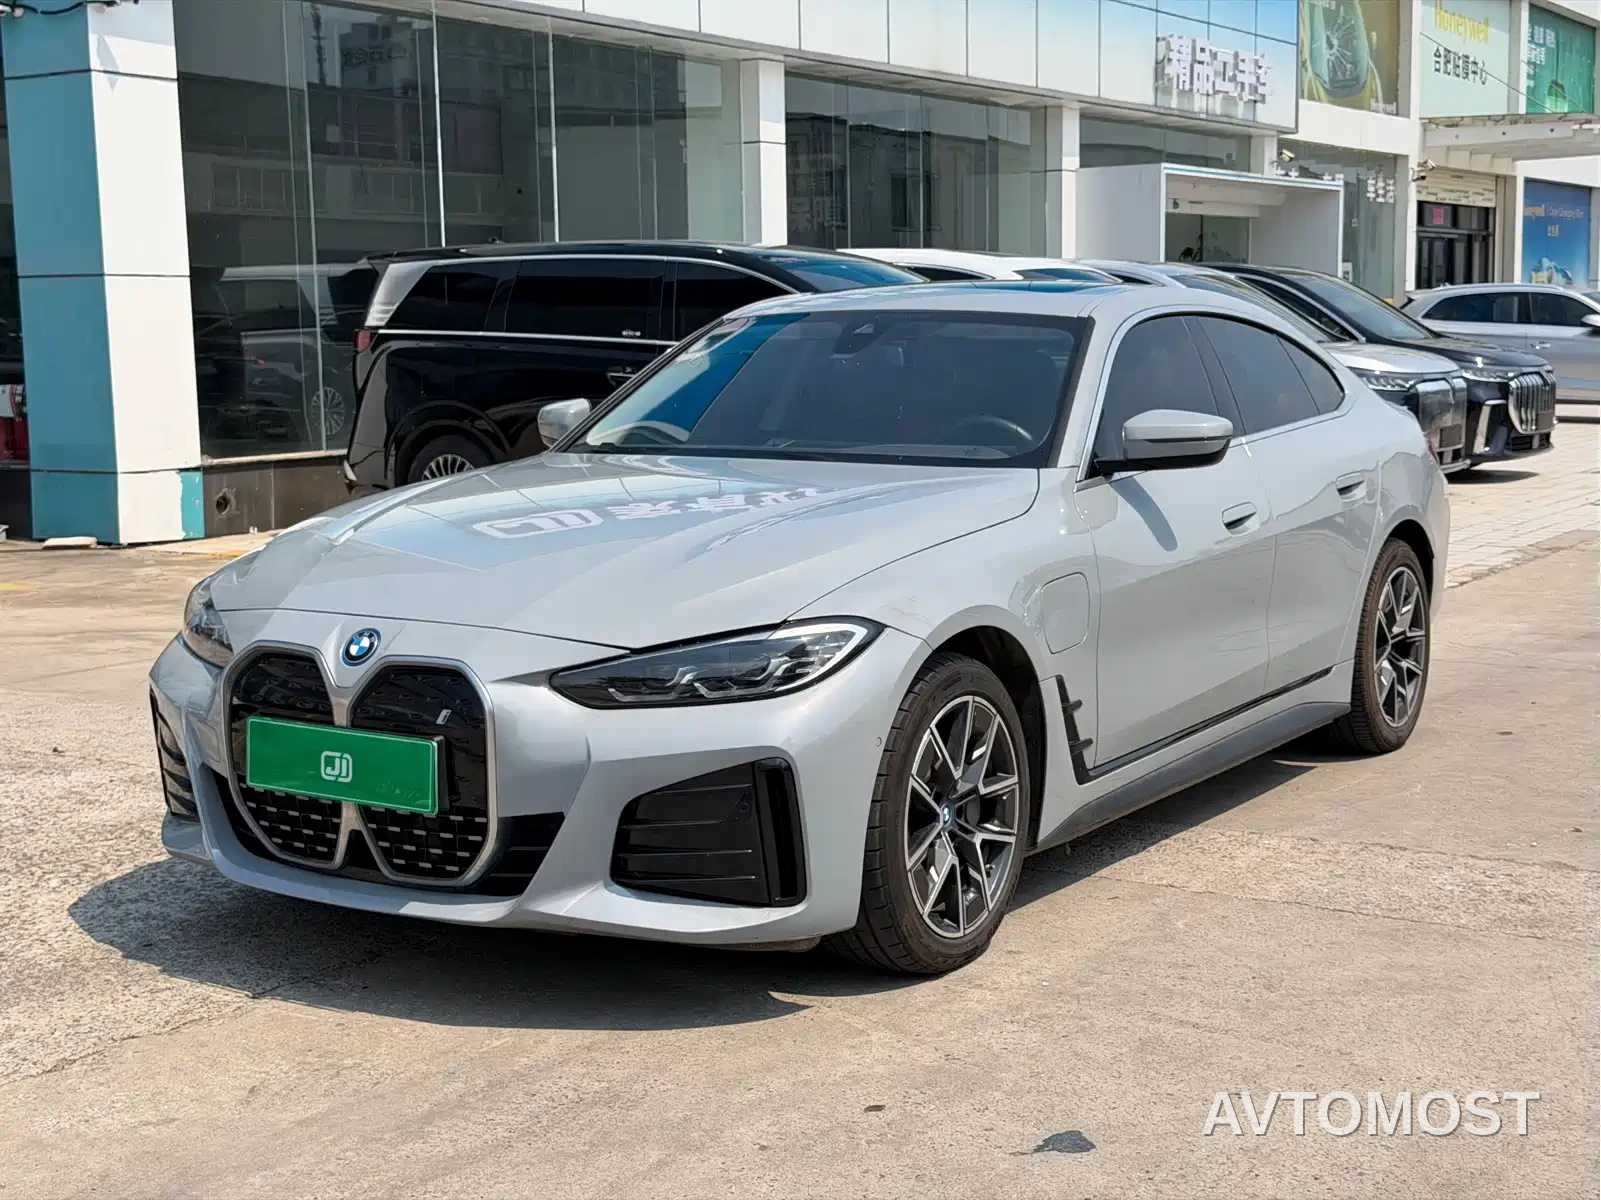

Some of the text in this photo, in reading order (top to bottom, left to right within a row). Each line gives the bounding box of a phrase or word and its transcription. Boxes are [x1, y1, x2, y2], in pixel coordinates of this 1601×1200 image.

[1434, 0, 1488, 44] Honeywell
[1433, 46, 1488, 86] 合肥贴膜中心
